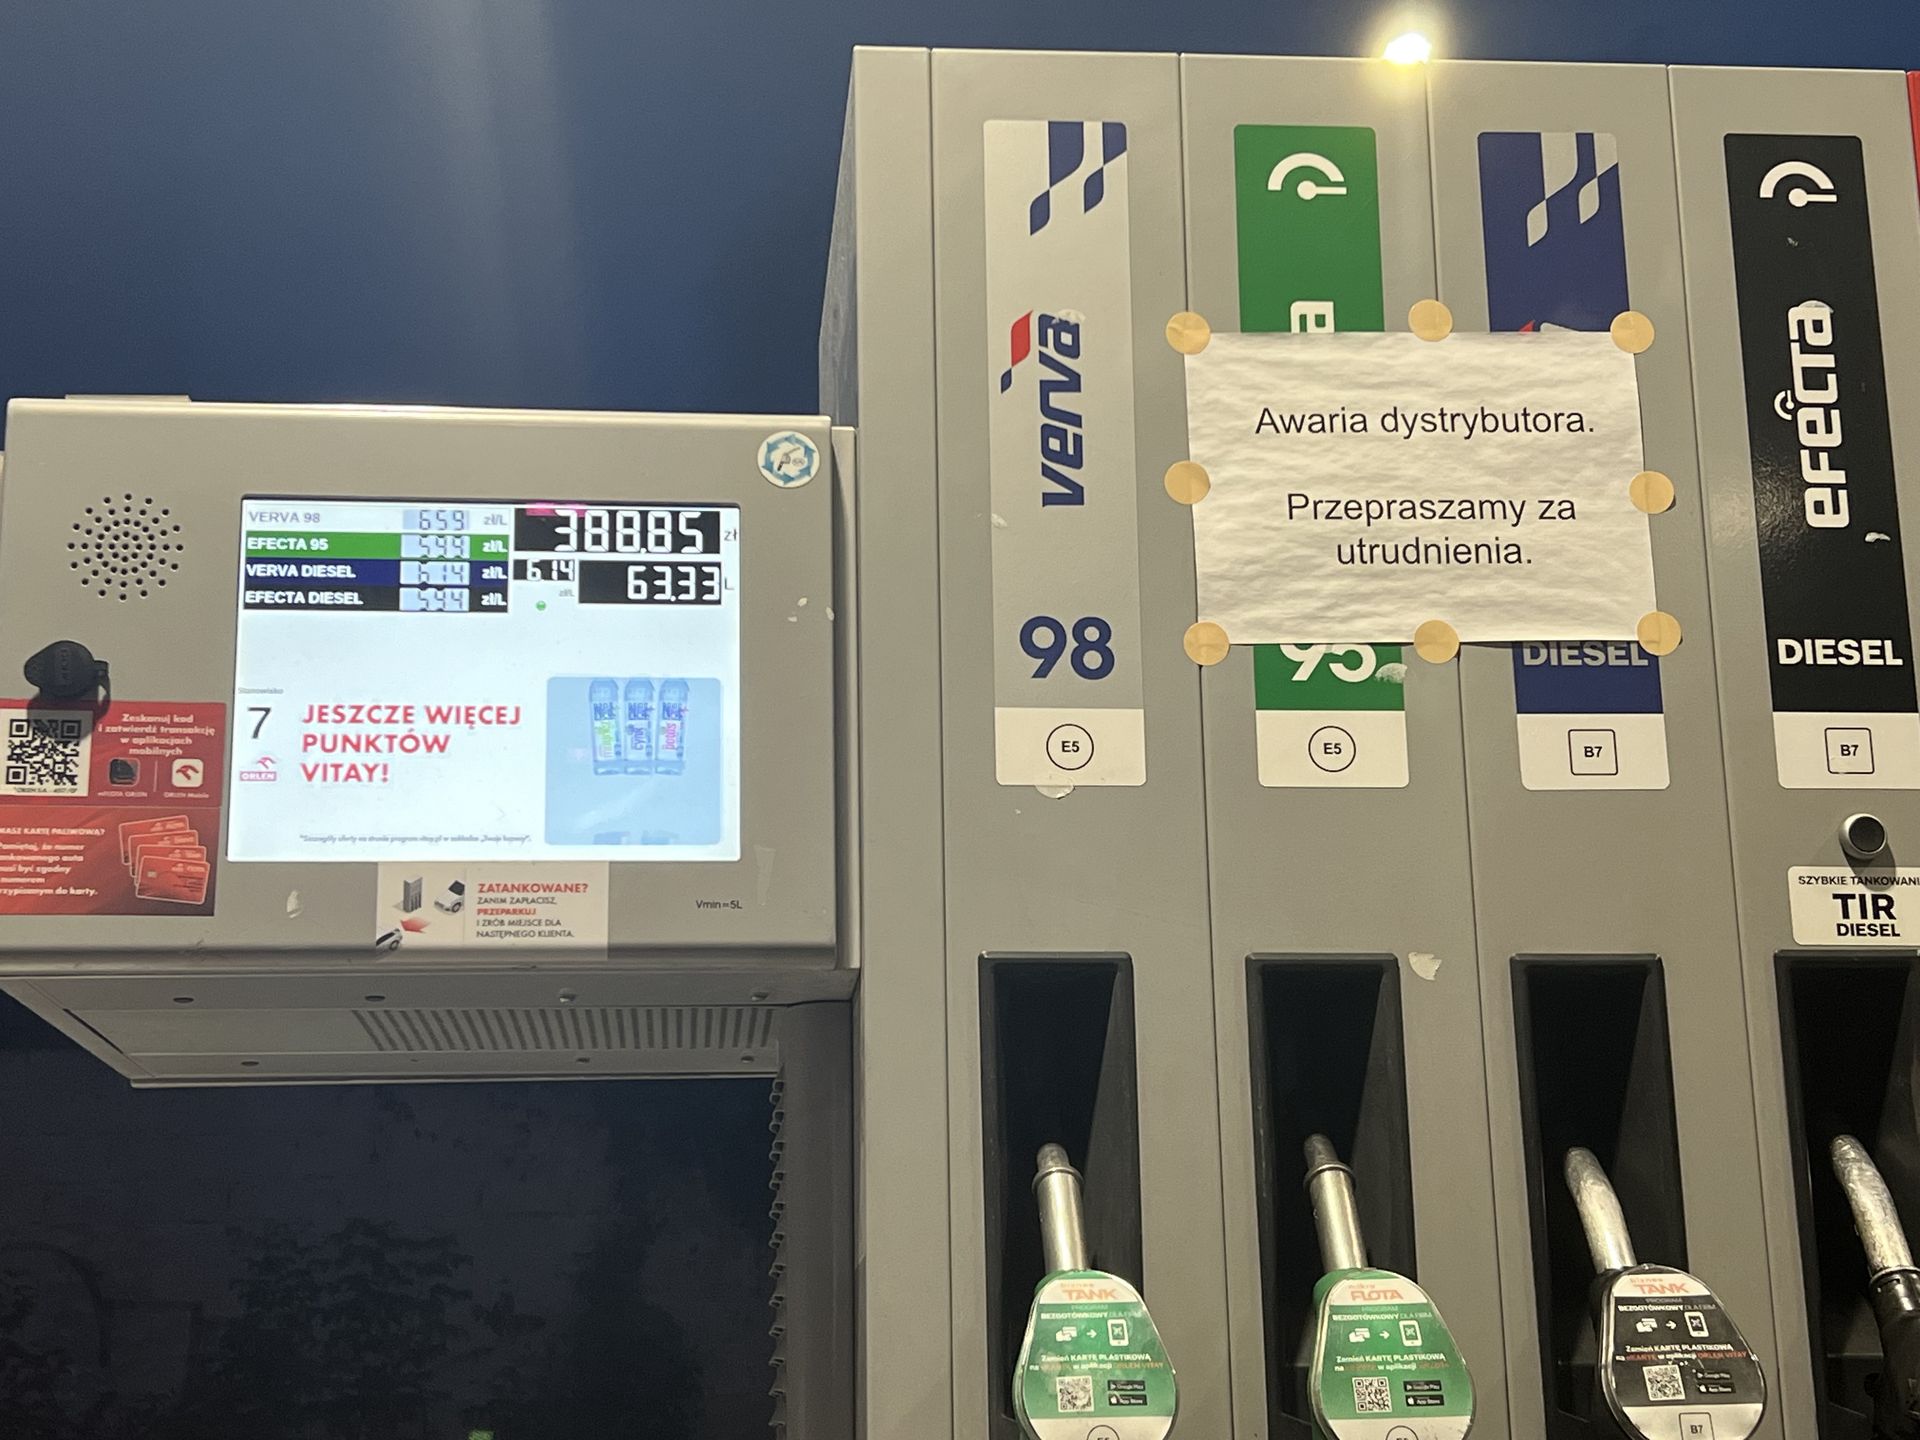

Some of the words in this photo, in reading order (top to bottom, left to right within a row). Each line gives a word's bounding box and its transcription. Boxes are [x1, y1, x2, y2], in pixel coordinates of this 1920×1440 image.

[1256, 406, 1369, 435] Awaria
[1380, 406, 1595, 440] dystrybutora.
[1286, 492, 1526, 526] Przepraszamy
[1538, 500, 1577, 521] za
[248, 511, 300, 523] VERVA
[303, 512, 321, 523] 98
[247, 537, 307, 550] EFECTA
[310, 538, 329, 551] 95
[1336, 536, 1533, 566] utrudnienia.
[246, 564, 299, 577] VERVA
[301, 565, 357, 578] DIESEL
[245, 591, 305, 603] EFECTA
[308, 592, 364, 605] DIESEL
[1019, 616, 1115, 679] 98
[1522, 641, 1649, 666] DIESEL
[1777, 639, 1904, 665] DIESEL
[1279, 643, 1378, 683] 95
[122, 714, 171, 724] Zeskanuj
[173, 714, 194, 723] kod
[248, 706, 272, 739] 7
[302, 704, 415, 725] JESZCZE
[425, 706, 521, 730] WIĘCEJ
[132, 736, 192, 745] aplikacjach
[302, 728, 450, 753] PUNKTÓW
[1061, 740, 1080, 754] E5
[129, 747, 182, 757] mobilnych
[1322, 742, 1342, 756] E5
[1583, 746, 1603, 759] B7
[1840, 744, 1859, 757] B7
[241, 772, 275, 780] ORLEN
[301, 763, 388, 783] VITAY!
[1798, 875, 1848, 885] SZYBKIE
[1850, 876, 1920, 886] TANKOWANI
[478, 883, 589, 893] ZATANKOWANE?
[477, 897, 507, 905] ZANIM
[1832, 893, 1897, 920] TIR
[482, 918, 505, 927] ZRÓB
[507, 919, 542, 927] MIEJSCE
[544, 919, 561, 927] DLA
[476, 930, 536, 939] NASTĘPNEGO
[1836, 923, 1901, 937] DIESEL
[1062, 1288, 1118, 1300] TANK
[1351, 1289, 1403, 1301] FLOTA
[1633, 1283, 1689, 1294] TANK
[1041, 1311, 1108, 1320] BEZGOTÓWKOWY
[1393, 1353, 1446, 1361] PLASTIKOWĄ
[1690, 1424, 1704, 1435] B7
